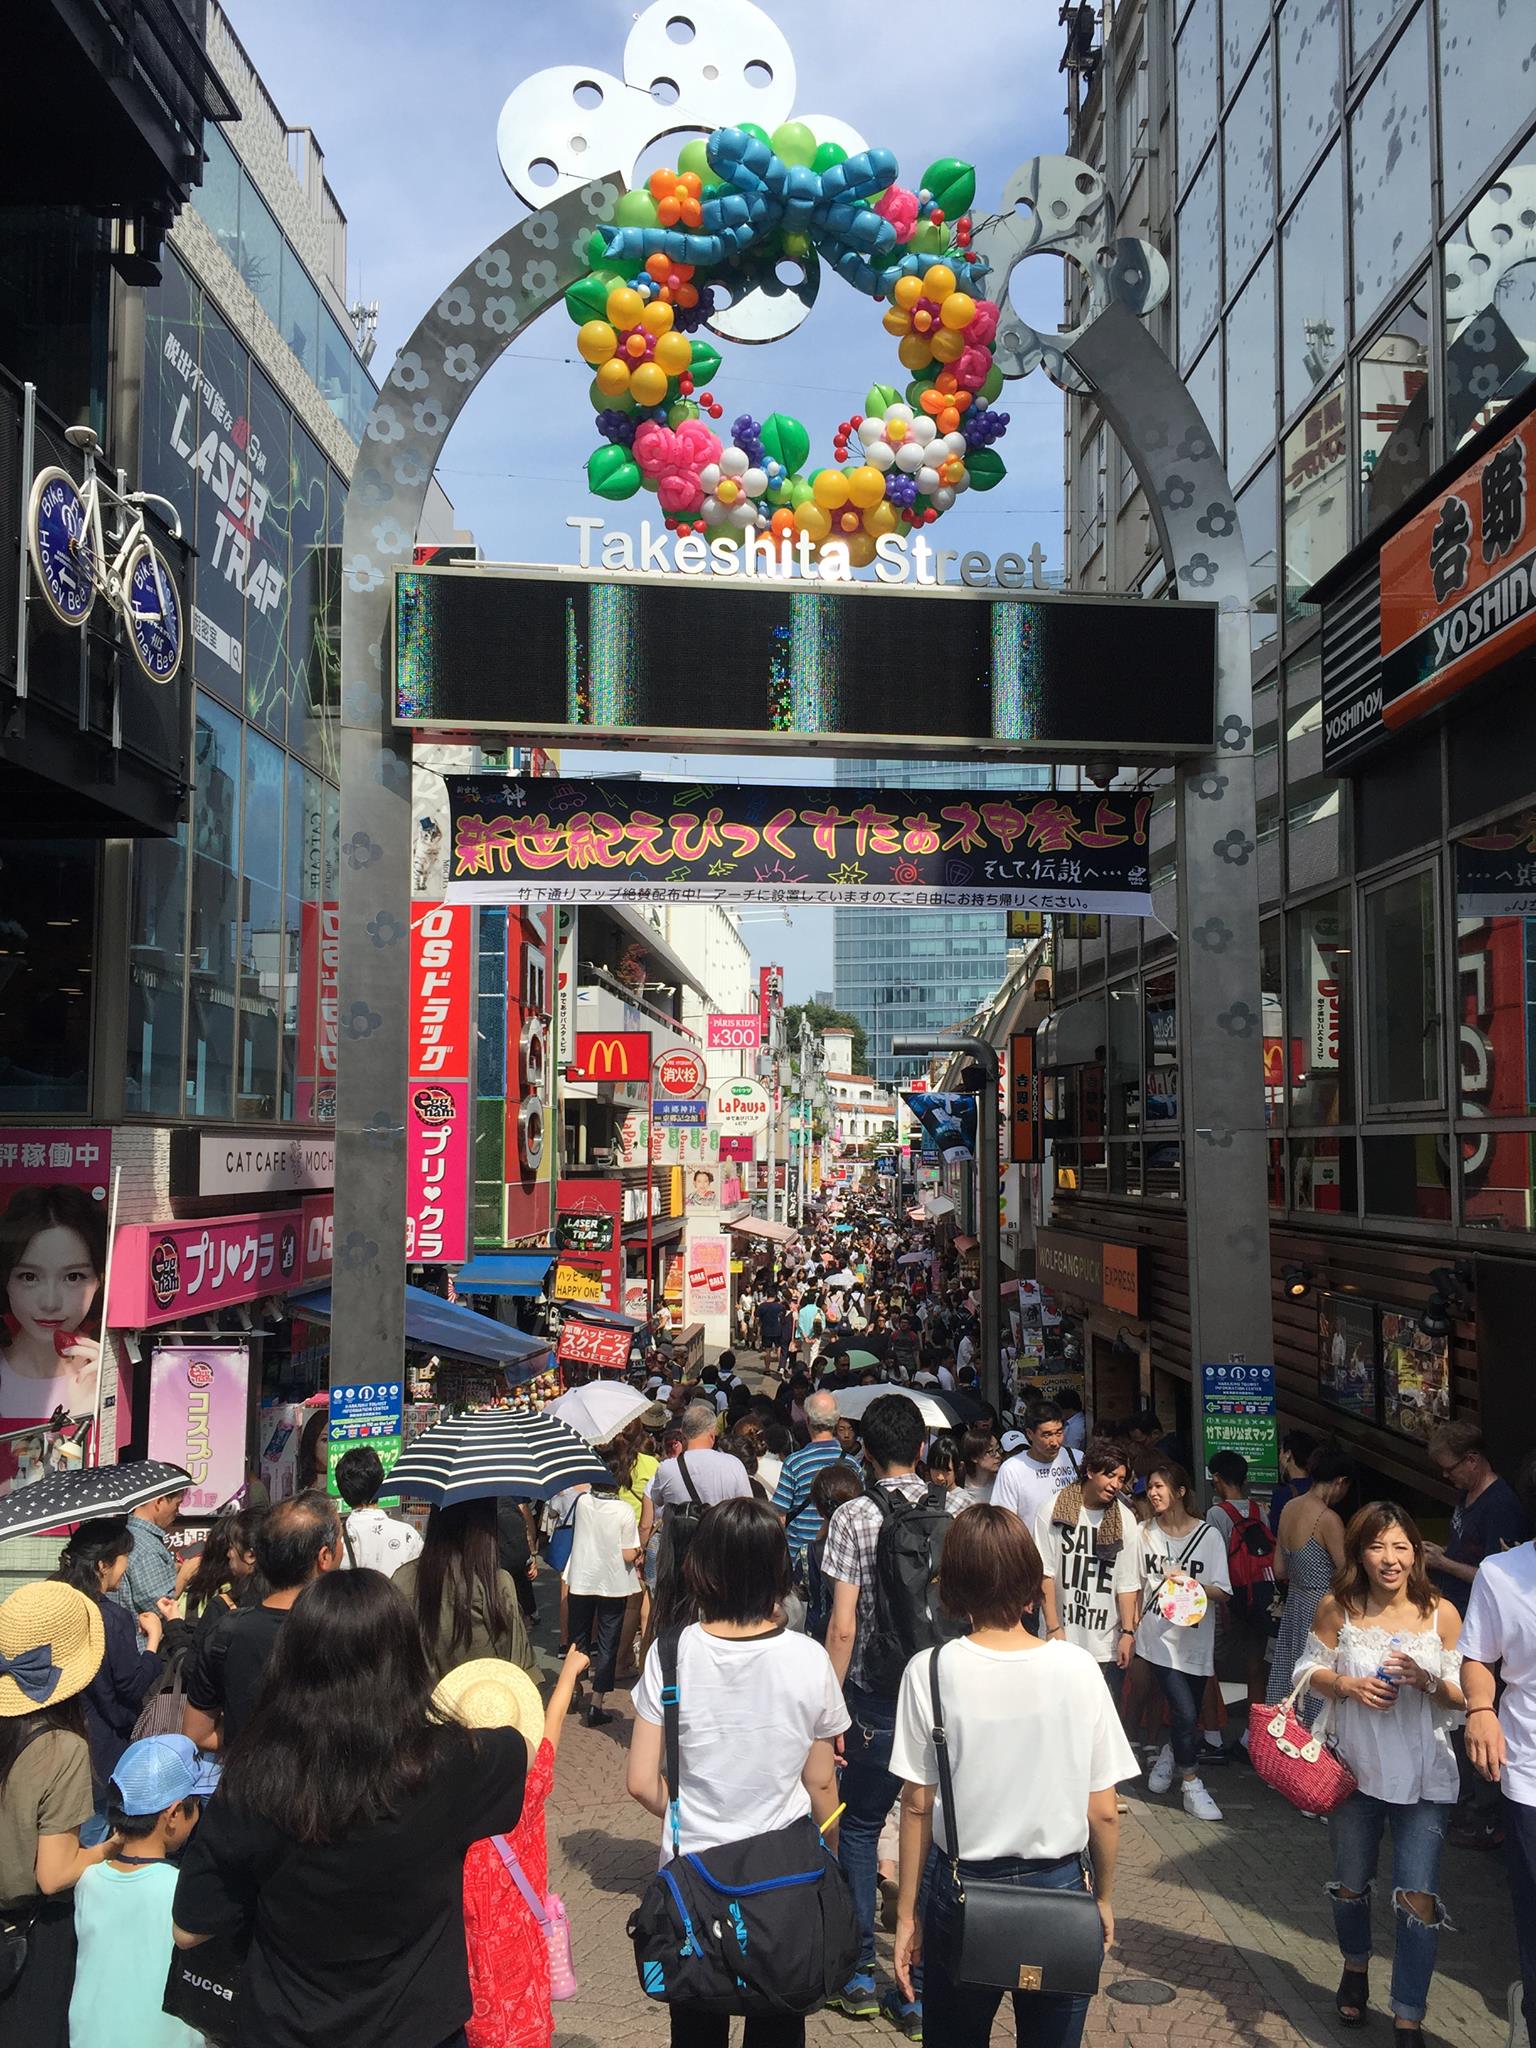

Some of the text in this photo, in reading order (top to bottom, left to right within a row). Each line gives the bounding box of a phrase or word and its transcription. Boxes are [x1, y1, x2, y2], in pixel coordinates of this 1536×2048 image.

[169, 393, 269, 540] LASER
[41, 487, 64, 518] Bike
[211, 510, 288, 616] TRAP
[566, 516, 1050, 591] Takeshita Street
[39, 529, 65, 606] Honey
[68, 587, 87, 611] Bee
[134, 561, 156, 590] Bike
[156, 649, 175, 671] Bee
[419, 910, 453, 1072] OSドラッグ
[713, 1019, 735, 1027] PARIS
[712, 1029, 755, 1046] ¥300
[663, 1067, 696, 1083] 消火栓
[718, 1098, 766, 1114] La Pausa
[226, 1151, 253, 1173] CAT
[255, 1149, 287, 1172] CAFE
[567, 1217, 599, 1230] LASER
[572, 1230, 599, 1241] TRAP
[1039, 1247, 1079, 1279] WOLFGANG
[1105, 1266, 1136, 1293] EXPRESS
[557, 1285, 600, 1298] HAPPY ONE
[561, 1347, 628, 1366] SQUEEZE
[562, 1334, 630, 1359] スクイーズ
[1040, 1384, 1081, 1394] XCHANGE
[186, 1391, 213, 1486] コスプリ
[1206, 1425, 1275, 1440] 竹下通り公式マップ
[1036, 1467, 1073, 1479] KEEP GOING
[1055, 1477, 1070, 1488] OWN
[1061, 1553, 1116, 1595] LIFE
[1074, 1589, 1090, 1607] ON
[182, 1969, 233, 2002] zucca
